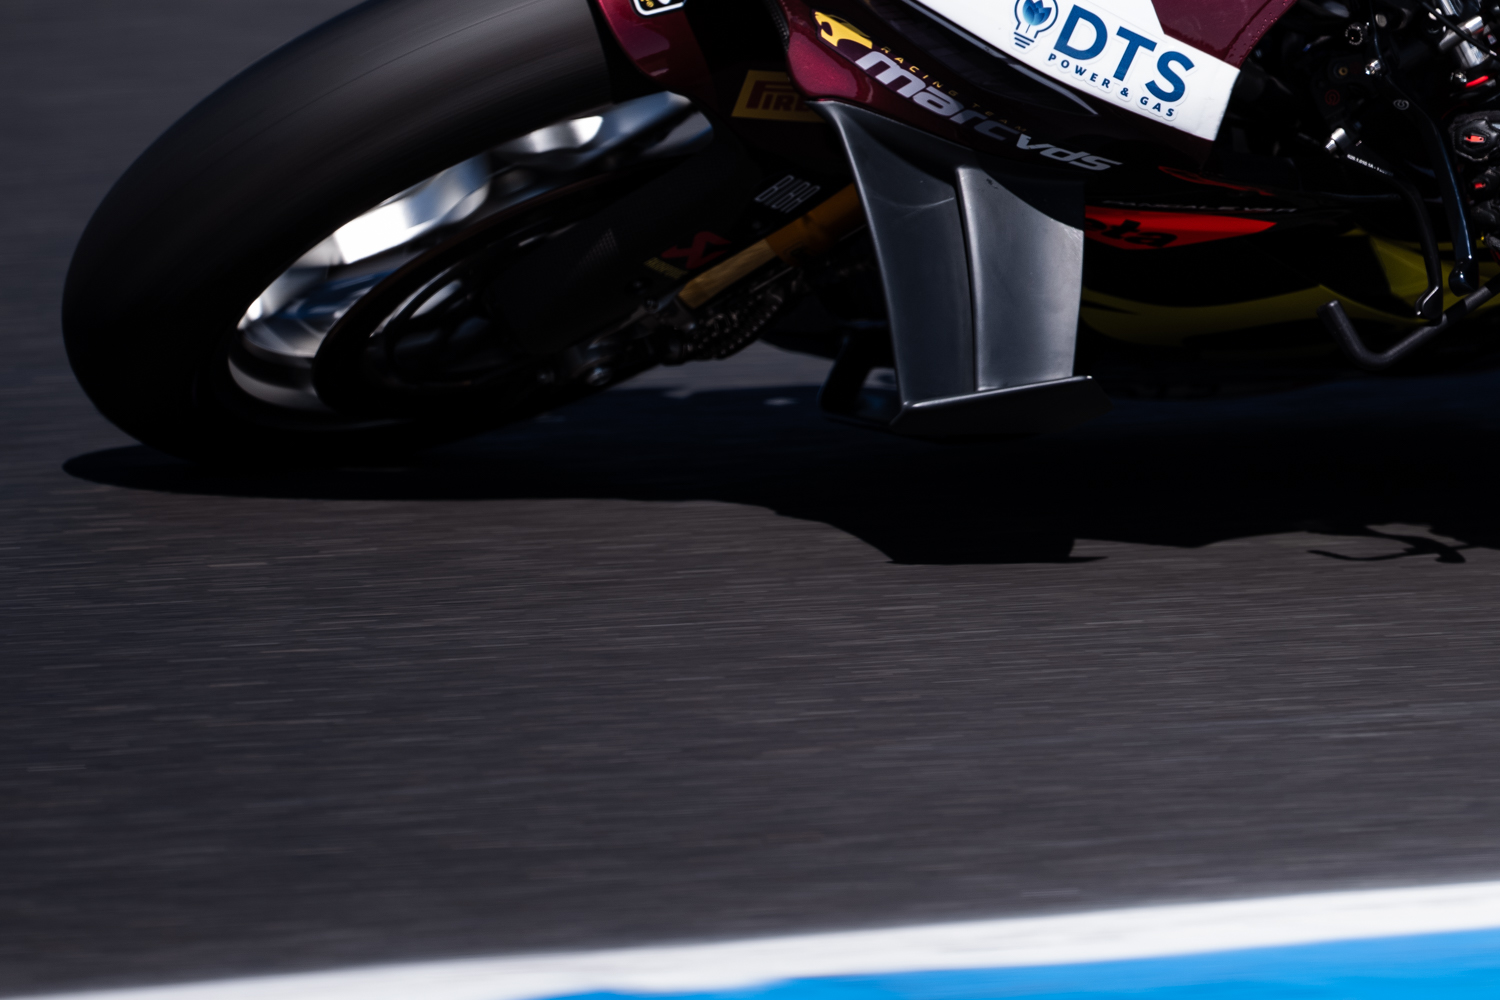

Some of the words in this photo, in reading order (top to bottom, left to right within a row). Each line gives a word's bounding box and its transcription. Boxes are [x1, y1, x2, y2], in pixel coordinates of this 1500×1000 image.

[880, 46, 959, 97] RACING
[971, 102, 1028, 133] TEAM
[1047, 52, 1111, 89] POWER
[1120, 86, 1129, 98] &
[1140, 96, 1176, 118] GAS
[1053, 4, 1195, 103] DTS
[855, 50, 1124, 172] marcvds
